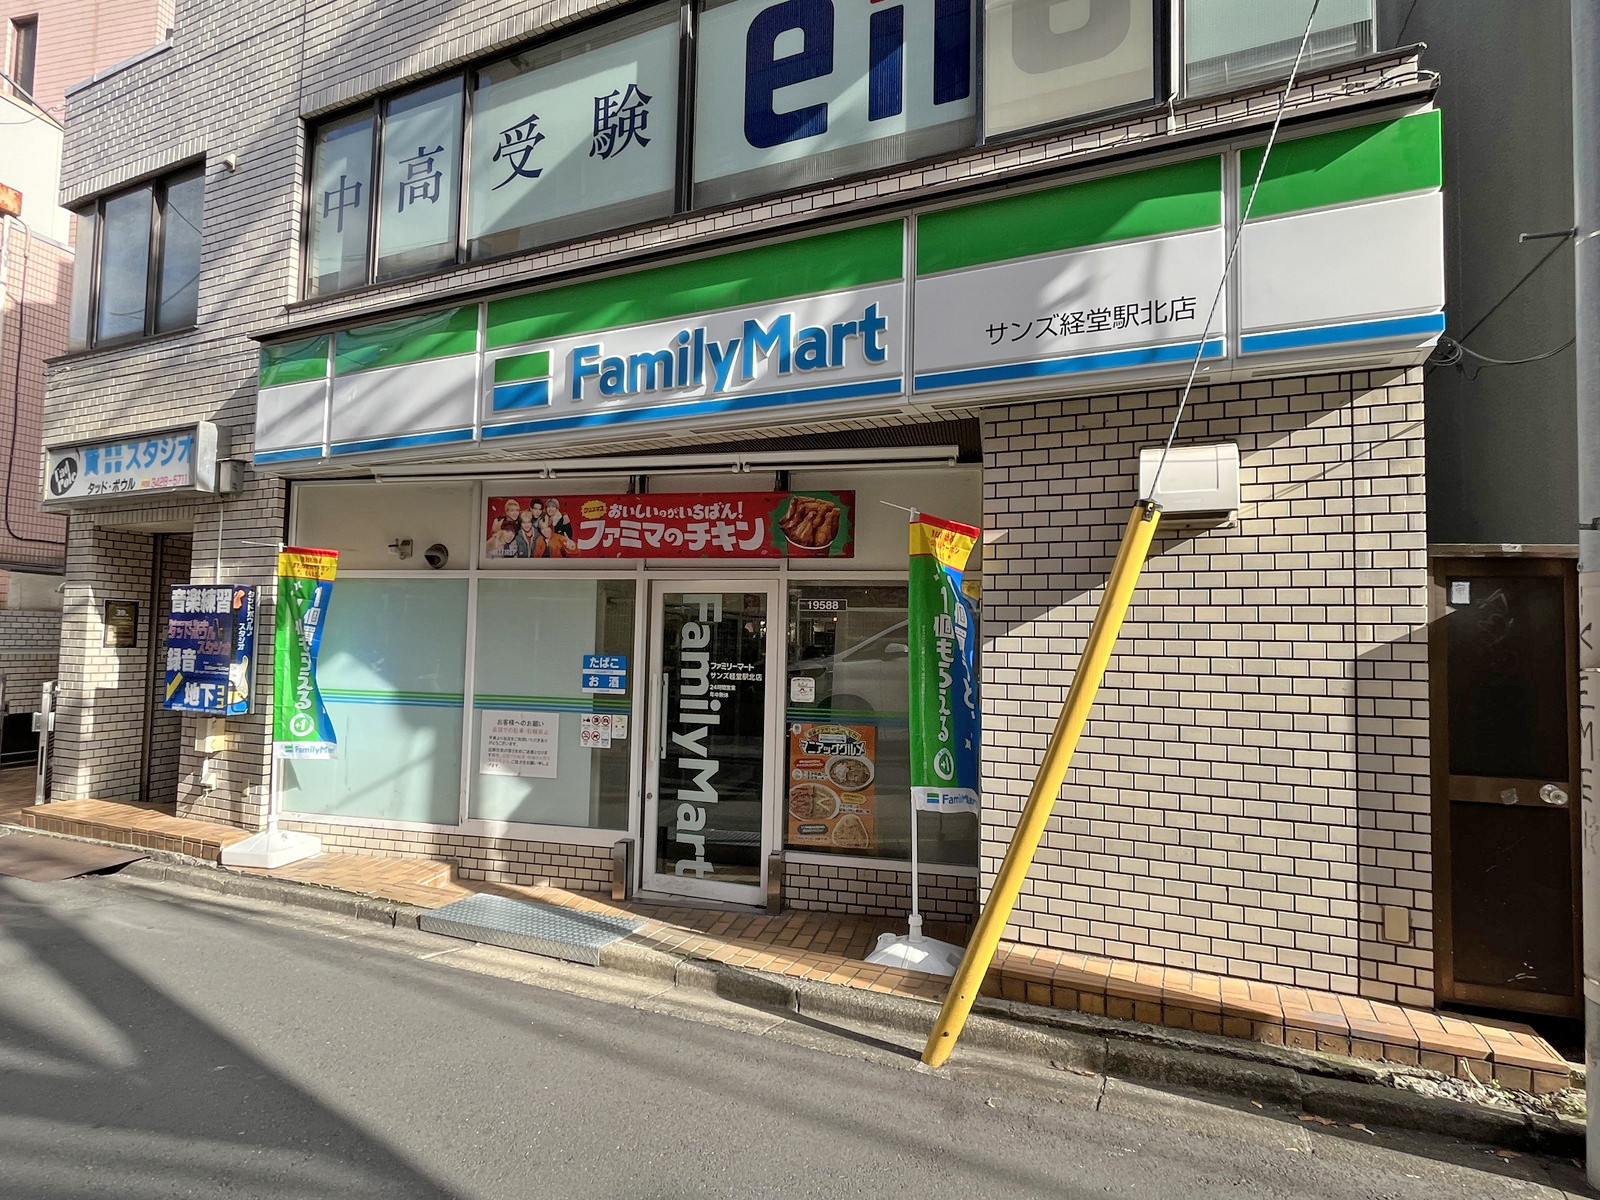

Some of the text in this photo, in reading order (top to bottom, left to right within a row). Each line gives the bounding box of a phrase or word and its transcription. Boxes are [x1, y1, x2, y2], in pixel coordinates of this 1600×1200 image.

[322, 83, 652, 233] 中高受験
[985, 296, 1197, 345] サンズ経堂駅北店
[571, 301, 889, 400] FamilyMart
[577, 517, 765, 551] ファミマのチキン
[171, 588, 232, 614] 音楽練習
[807, 600, 839, 610] 19588
[166, 647, 197, 673] 録音
[589, 657, 620, 669] たばこ
[710, 662, 755, 672] ファミリーマート
[184, 682, 216, 707] 地下
[671, 594, 723, 879] FamilyMart
